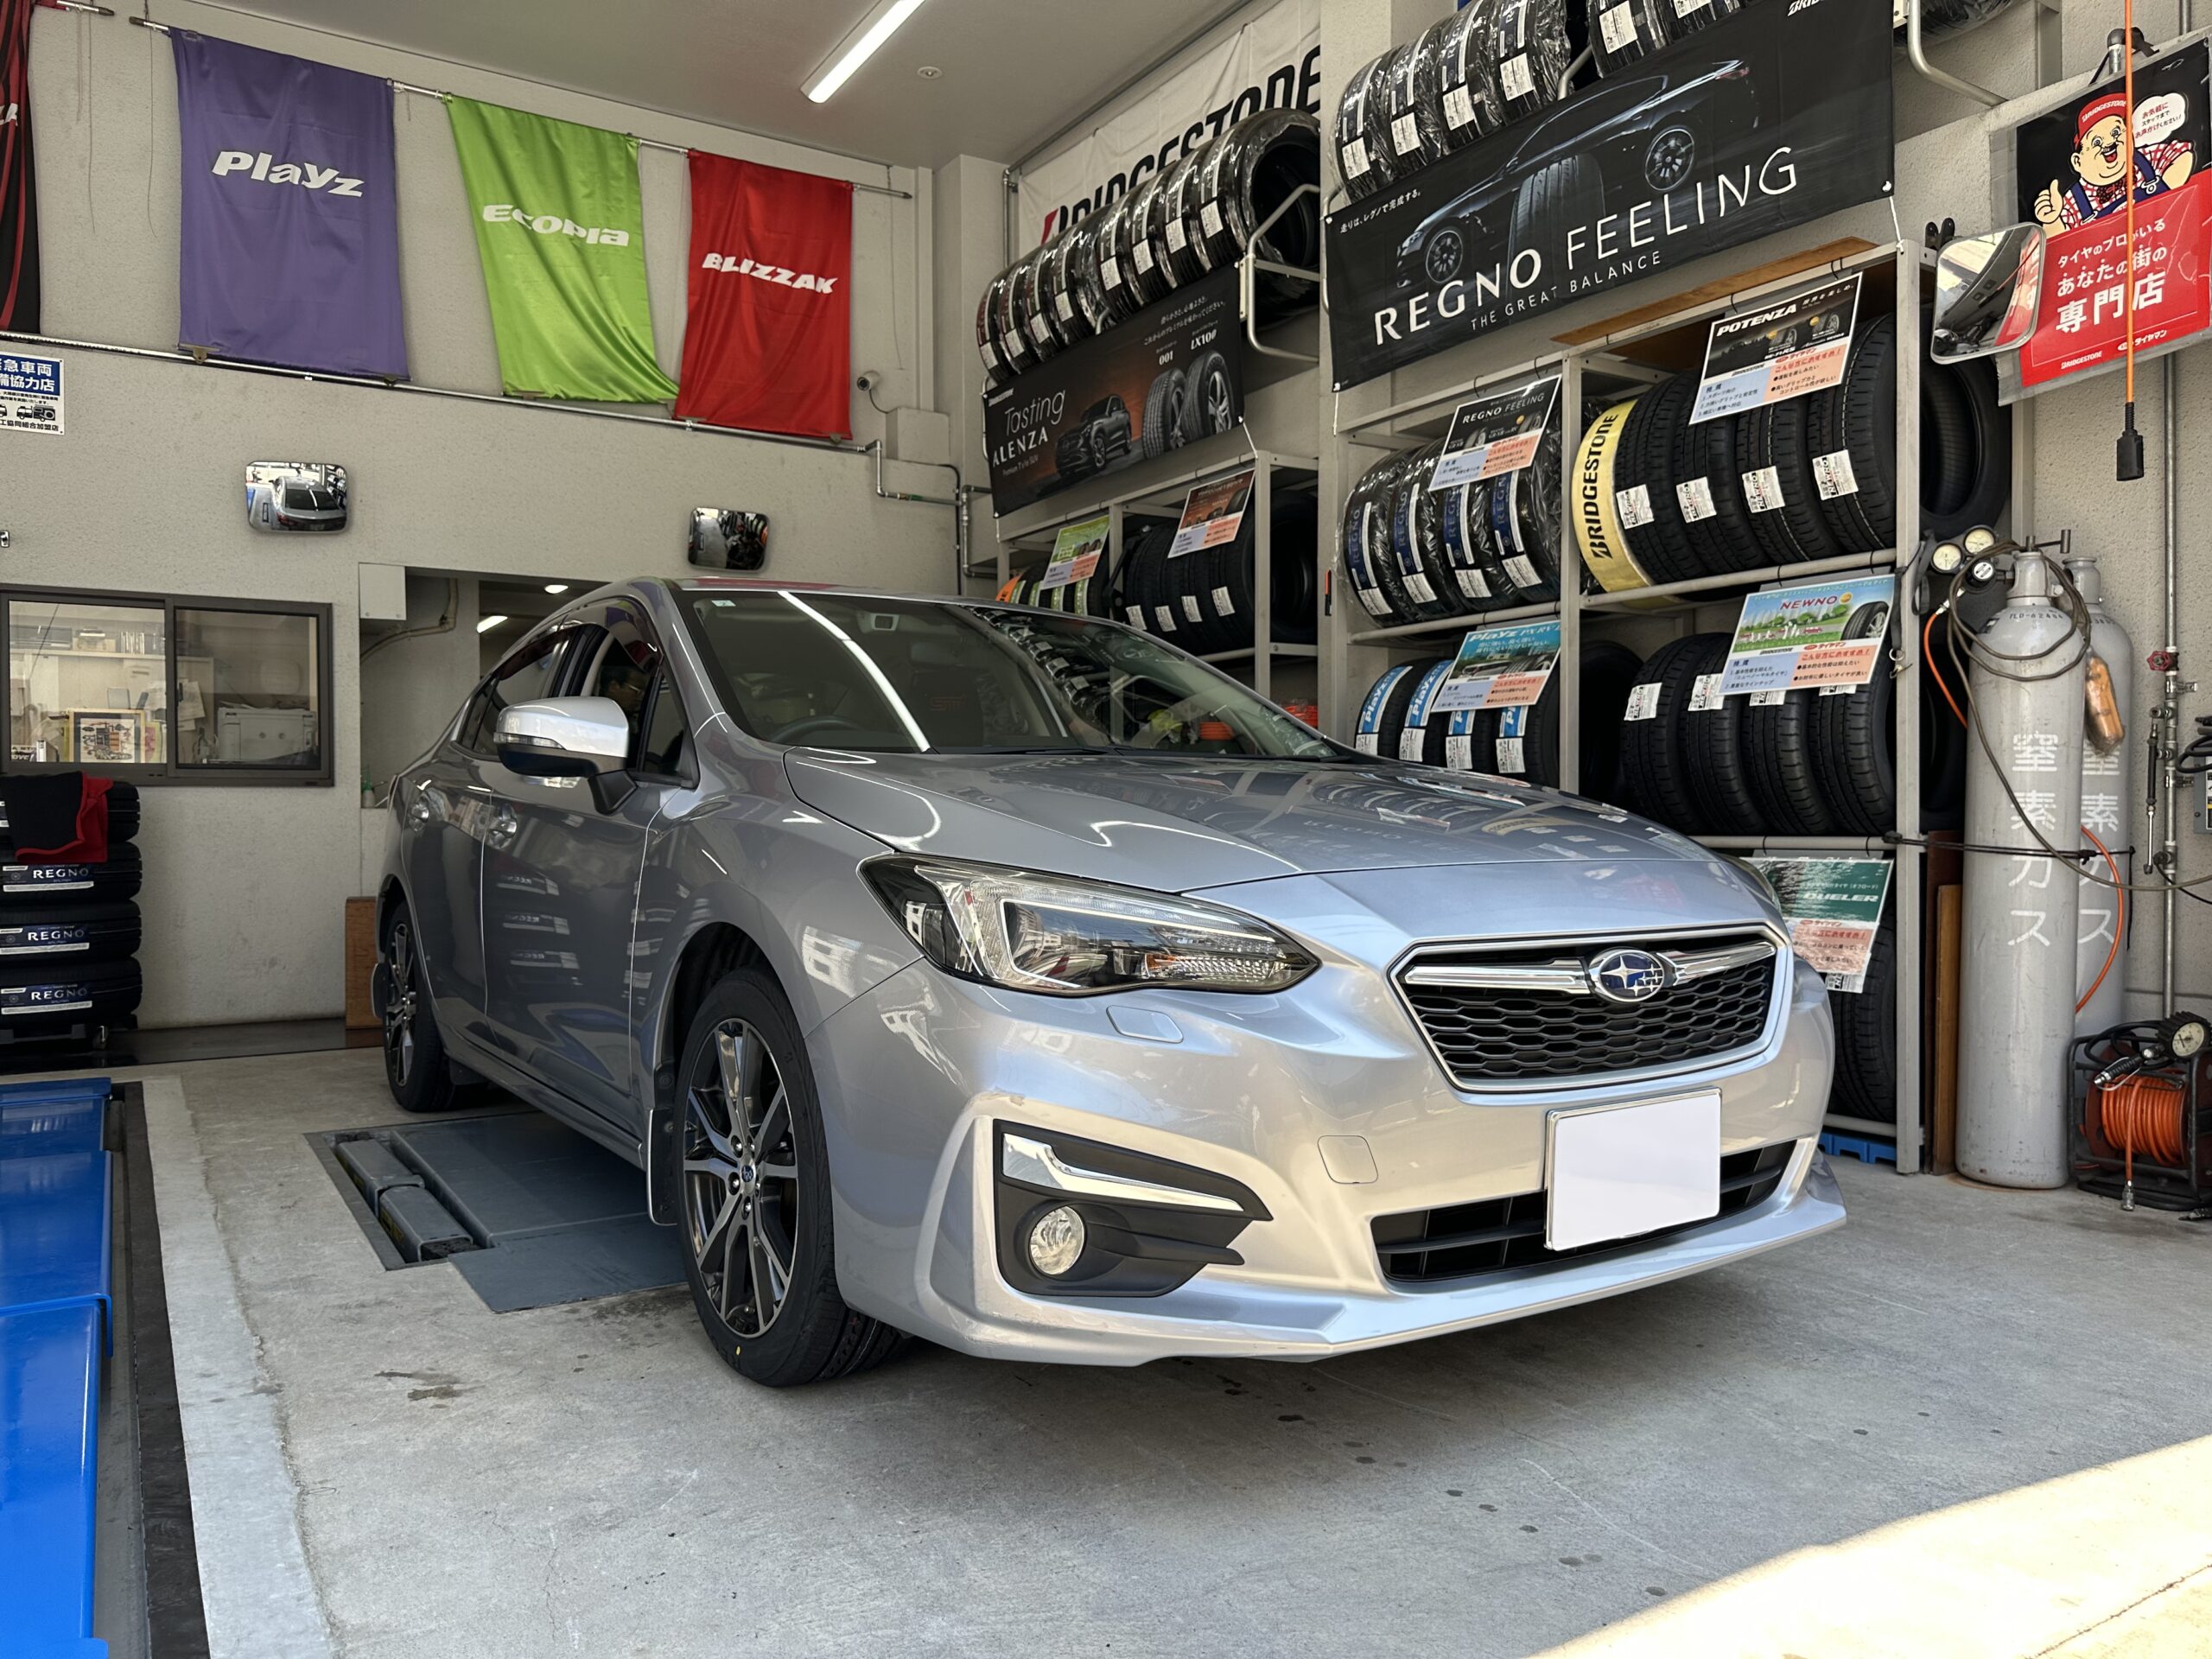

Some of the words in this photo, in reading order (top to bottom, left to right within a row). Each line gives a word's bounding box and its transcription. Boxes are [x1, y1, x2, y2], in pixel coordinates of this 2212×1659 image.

[2141, 111, 2170, 126] スタッフまで
[2143, 102, 2169, 118] お気軽に
[212, 150, 365, 197] Playz
[1340, 188, 1421, 233] 走りは、レグノで完成する。
[1374, 248, 1541, 346] REGNO
[1567, 146, 1797, 270] FEELING
[702, 252, 839, 295] BLIZZAK
[2056, 245, 2168, 297] あなたの街の
[1471, 310, 1497, 331] THE
[1504, 286, 1558, 317] GREAT
[1569, 251, 1661, 293] BALANCE
[2056, 270, 2167, 334] 専門店
[1716, 304, 1797, 337] POTENZA
[2134, 329, 2168, 346] タイヤマン
[0, 359, 52, 377] 急車両
[2061, 351, 2102, 370] BRIDGESTONE
[1004, 390, 1066, 436] Tasting
[1462, 407, 1502, 424] REGNO
[1504, 392, 1545, 412] FEELING
[992, 426, 1049, 468] ALENZA
[1582, 413, 1619, 560] BRIDGESTONE
[1780, 595, 1838, 611] NEWNO
[1469, 630, 1520, 642] Playz
[1817, 641, 1847, 650] タイヤマン
[1412, 672, 1436, 717] Playz
[33, 867, 89, 879] REGNO
[28, 929, 84, 941] REGNO
[31, 988, 87, 1001] REGNO
